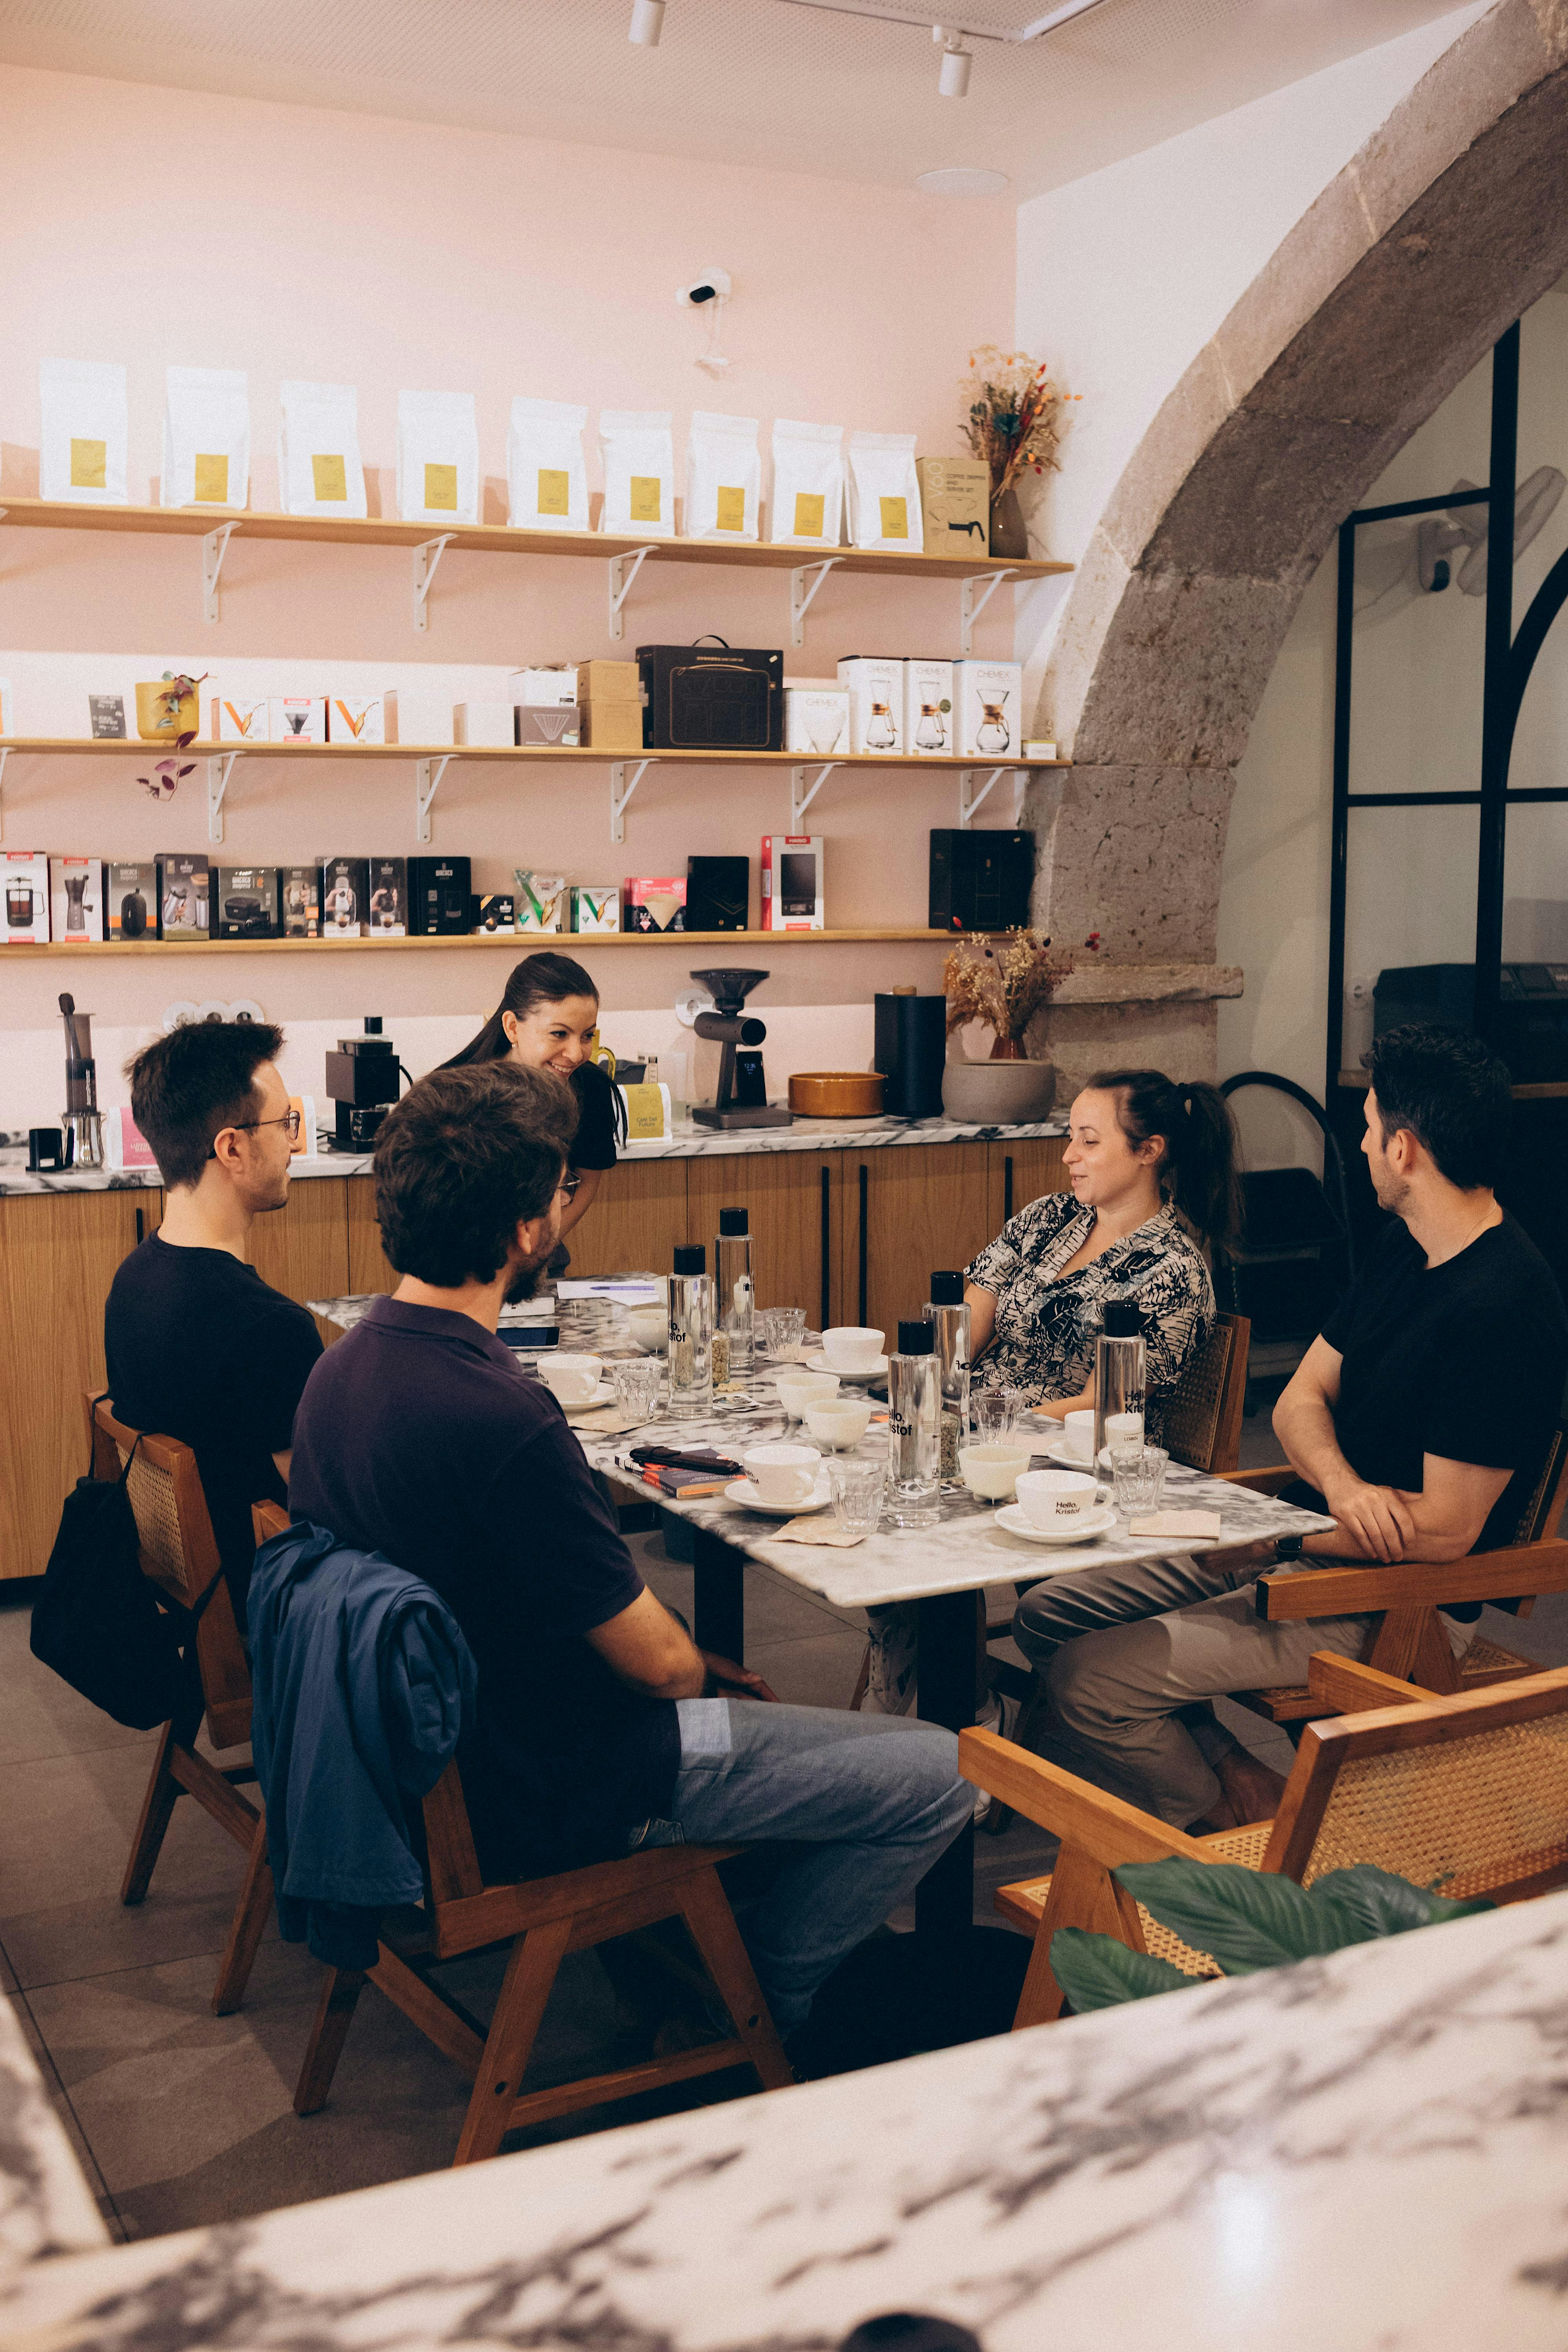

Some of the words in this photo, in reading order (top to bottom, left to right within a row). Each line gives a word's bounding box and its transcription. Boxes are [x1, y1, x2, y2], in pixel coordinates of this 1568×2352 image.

[867, 665, 898, 673] CHEMEX
[977, 670, 1010, 678] CHEMEX
[806, 698, 837, 707] CHEMEX
[668, 1319, 680, 1333] llo,
[668, 1330, 686, 1342] istof
[1125, 1402, 1145, 1414] Kris
[889, 1421, 912, 1436] istof
